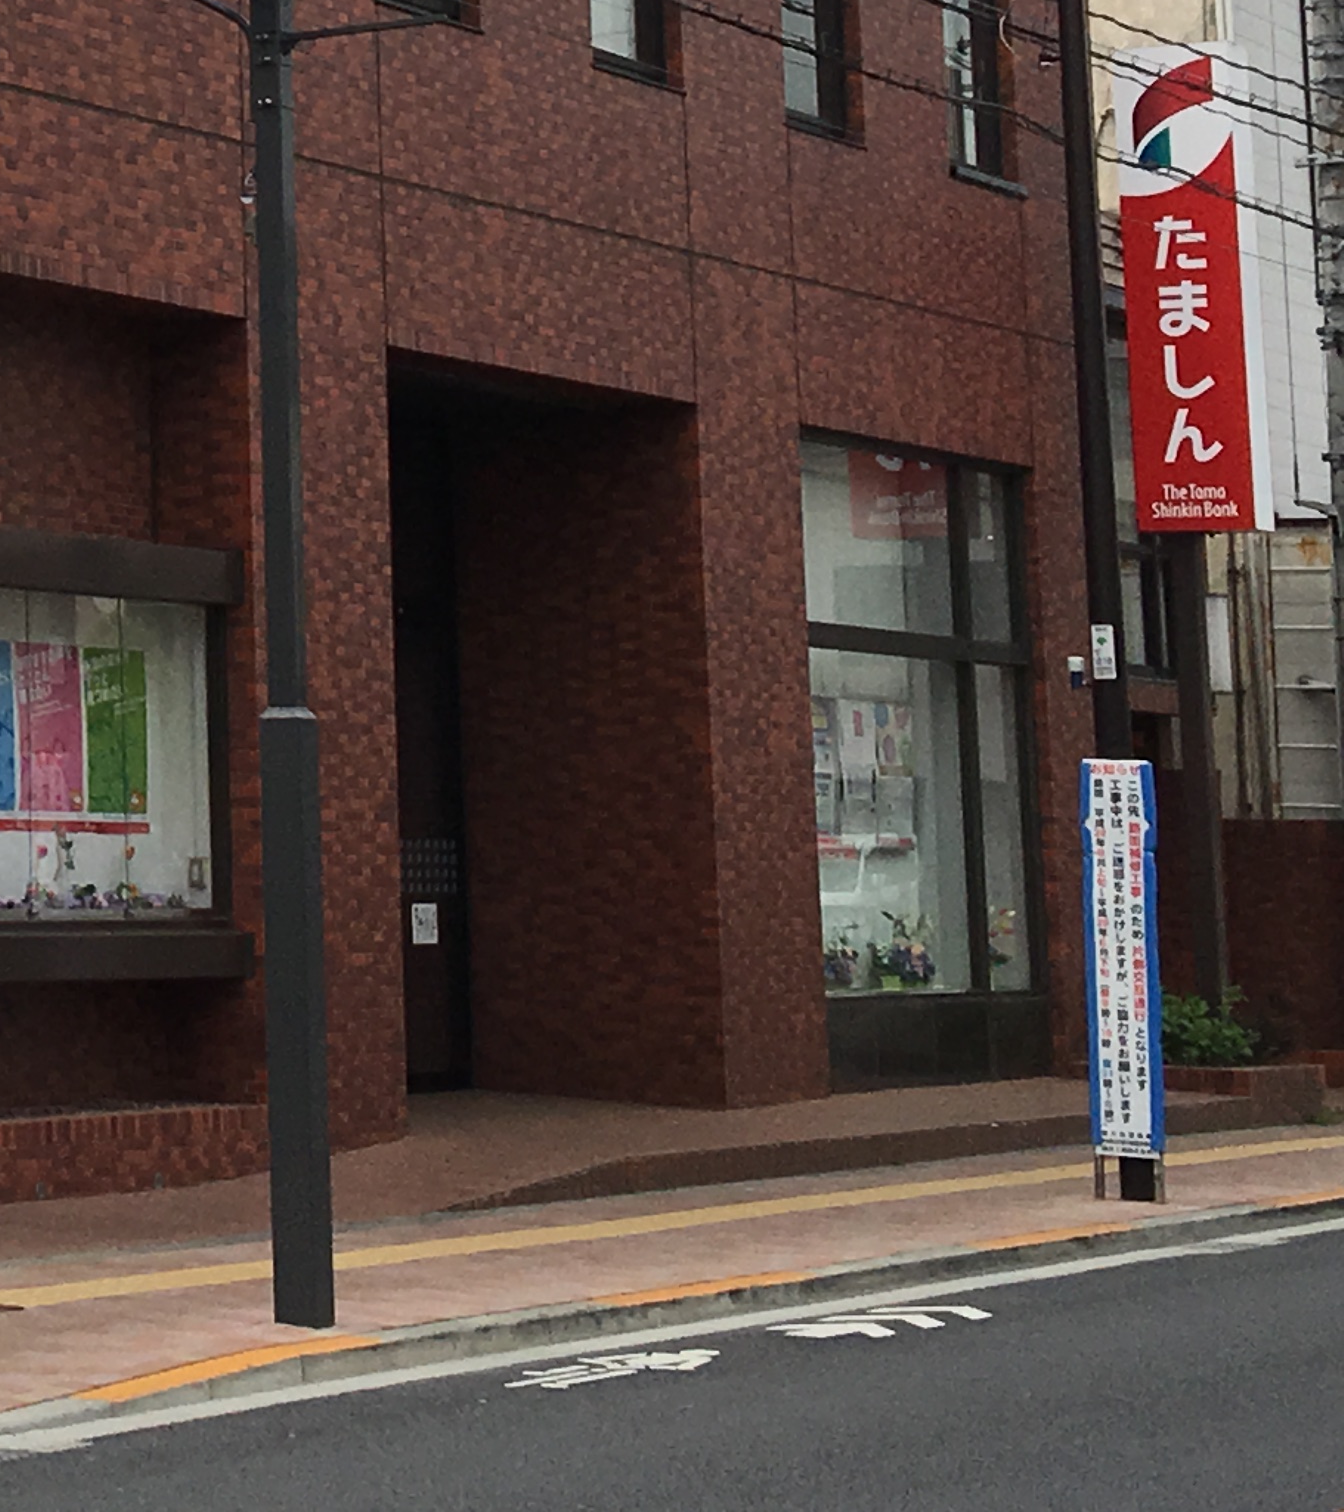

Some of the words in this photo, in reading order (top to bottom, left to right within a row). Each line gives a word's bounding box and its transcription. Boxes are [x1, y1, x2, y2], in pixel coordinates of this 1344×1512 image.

[1153, 215, 1224, 464] たましん
[1161, 483, 1188, 500] The
[1188, 483, 1227, 500] Tama
[1151, 501, 1203, 519] Shinkin
[1203, 500, 1240, 518] Bank
